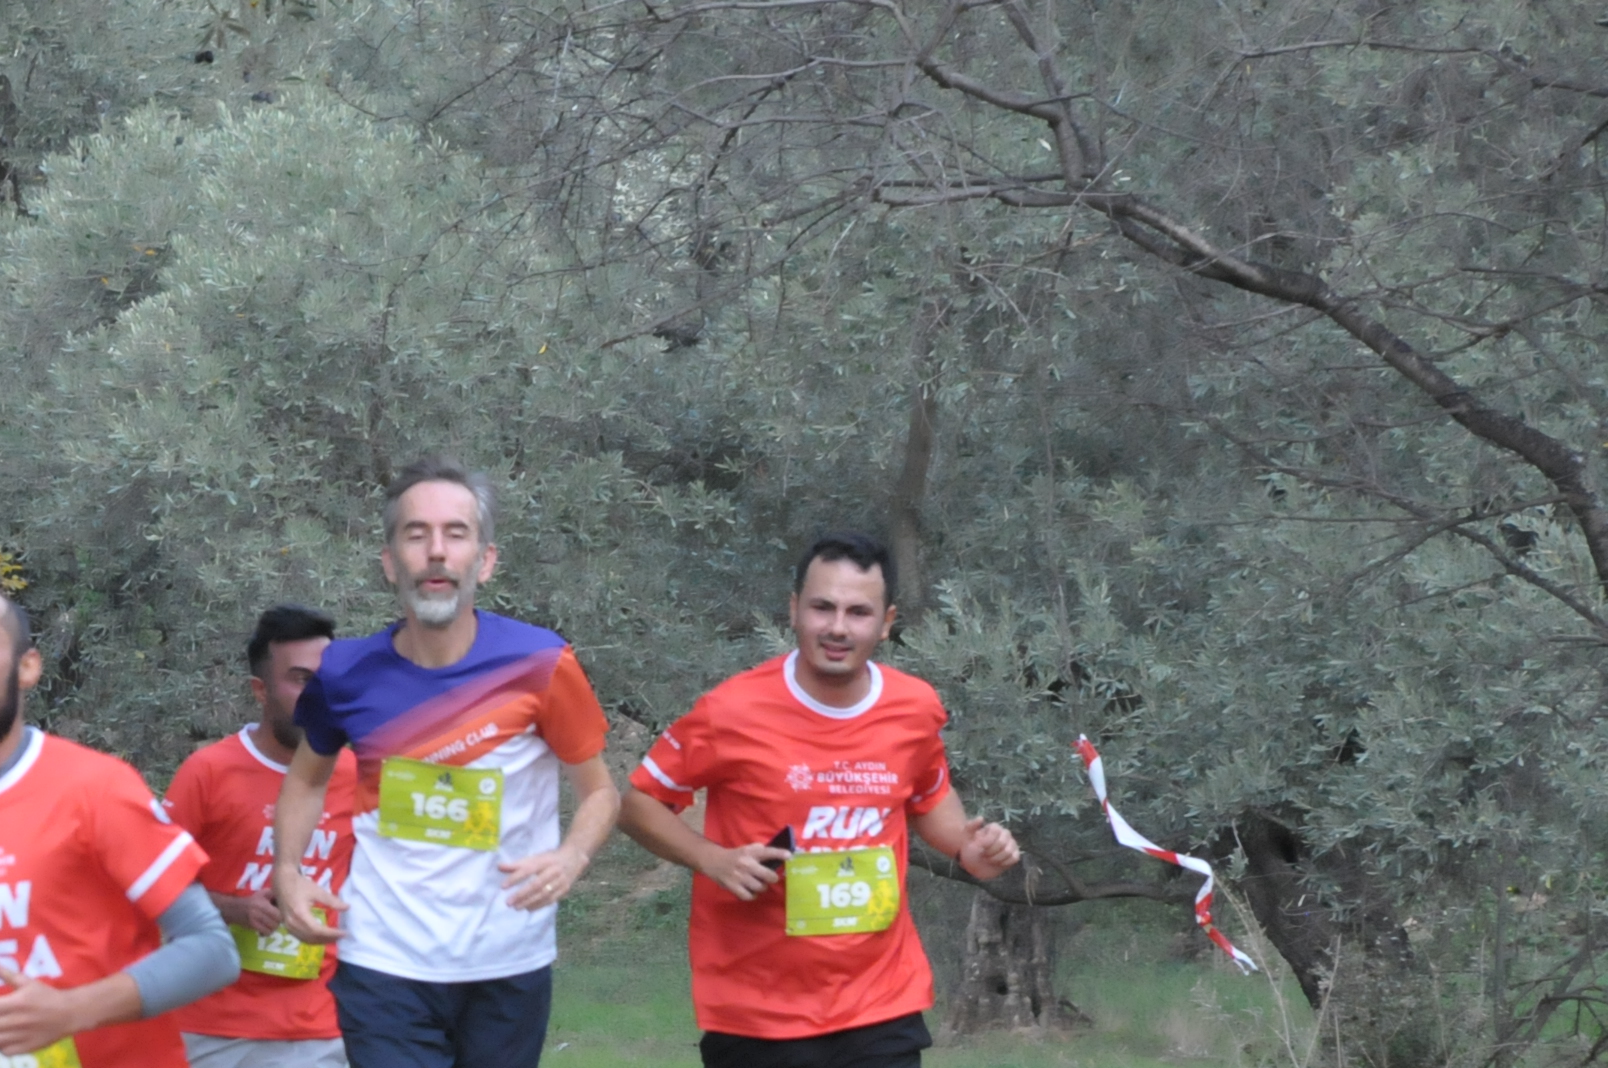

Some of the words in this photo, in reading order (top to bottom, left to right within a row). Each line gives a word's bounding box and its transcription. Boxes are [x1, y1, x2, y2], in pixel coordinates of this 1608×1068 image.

[466, 721, 499, 747] CLUB
[854, 761, 887, 771] AYDIN
[410, 791, 469, 823] 166
[801, 806, 891, 839] RUN
[816, 881, 871, 909] 169
